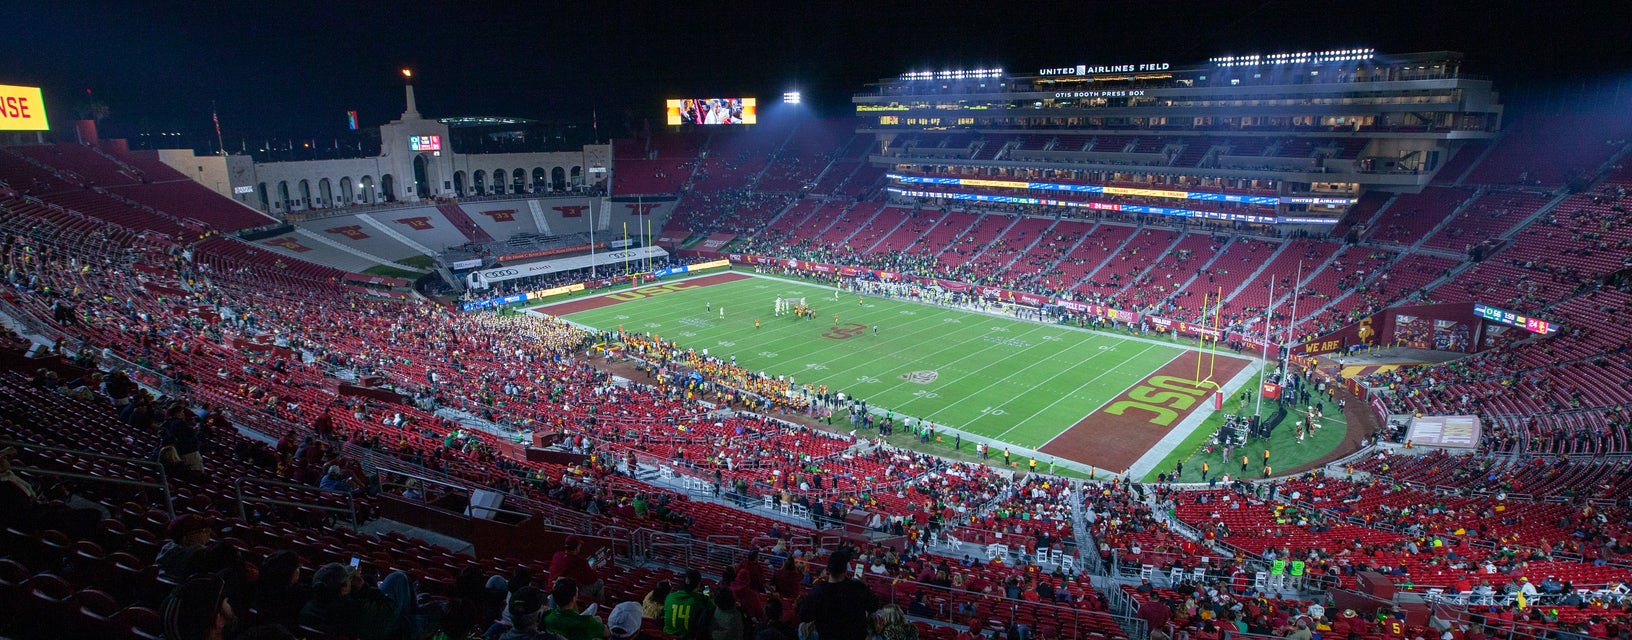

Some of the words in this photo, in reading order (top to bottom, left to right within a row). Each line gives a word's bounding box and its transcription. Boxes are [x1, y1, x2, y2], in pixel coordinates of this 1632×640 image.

[1040, 67, 1075, 75] UNITED
[1087, 64, 1135, 74] AIRLINES
[1139, 62, 1170, 71] FIELD
[528, 264, 552, 272] Audi
[605, 283, 701, 301] USC
[1487, 324, 1501, 332] 37
[1529, 320, 1538, 328] 24
[1305, 343, 1319, 353] WE
[1321, 340, 1339, 351] ARE
[1103, 375, 1216, 427] USC
[672, 604, 691, 631] 14
[1392, 622, 1401, 634] 5
